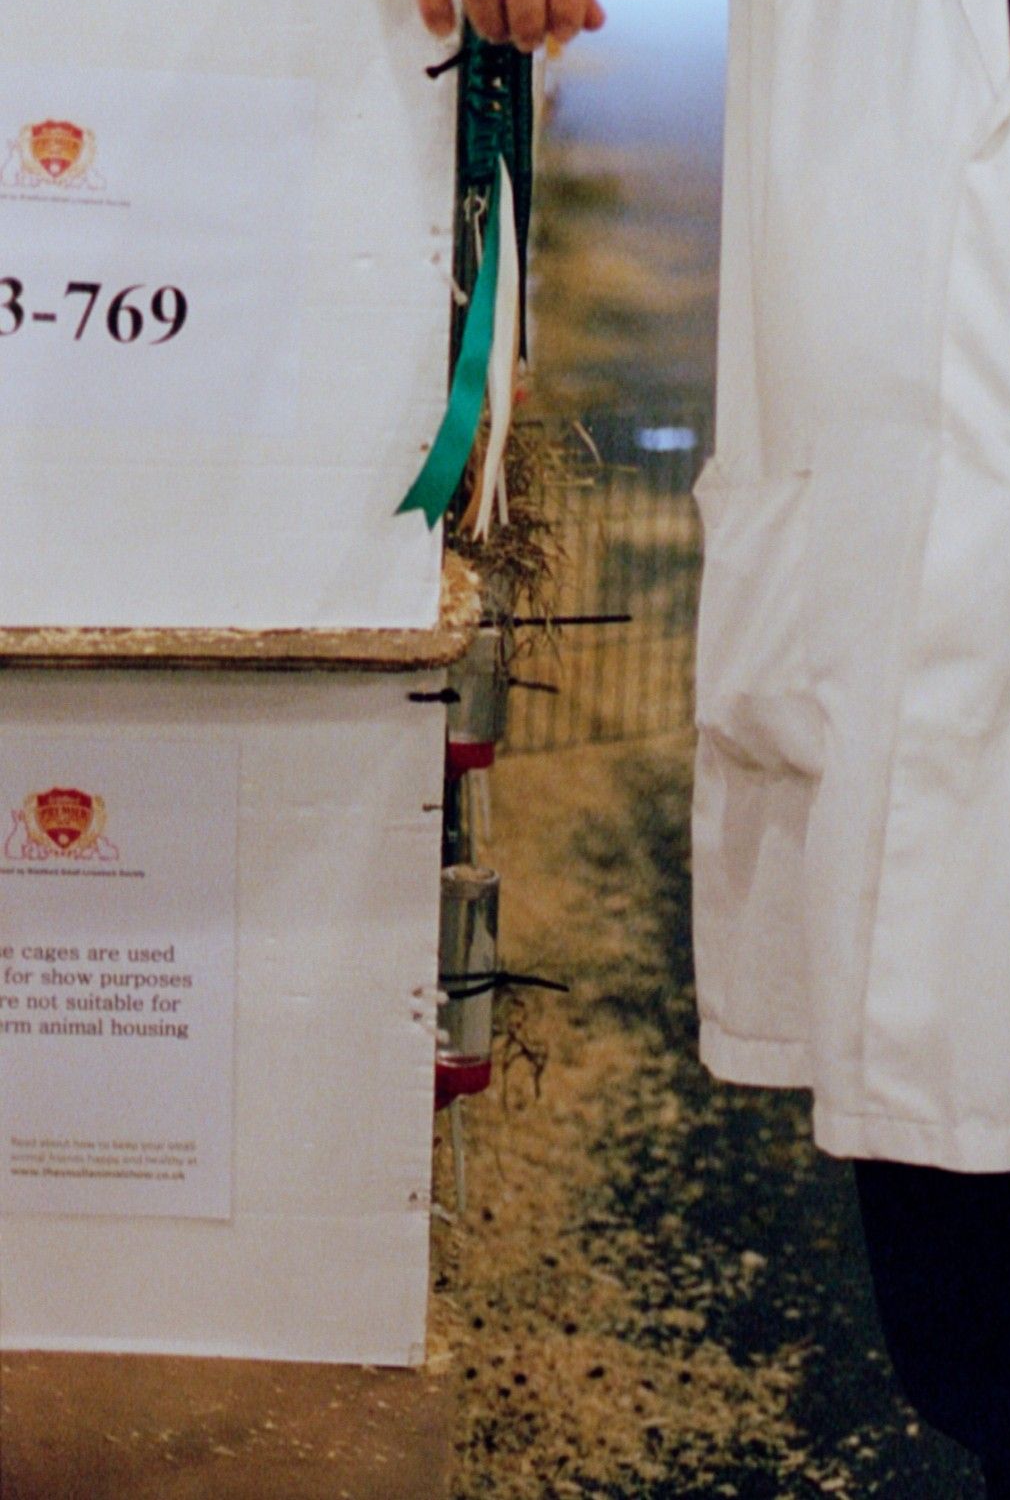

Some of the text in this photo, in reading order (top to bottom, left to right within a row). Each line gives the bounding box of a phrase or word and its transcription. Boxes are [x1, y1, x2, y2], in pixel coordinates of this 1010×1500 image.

[21, 946, 80, 963] cages
[87, 948, 120, 962] are
[127, 945, 176, 963] used
[4, 967, 193, 989] for show purposes
[27, 995, 58, 1010] not
[66, 993, 144, 1012] suitable
[152, 994, 182, 1013] for
[39, 1018, 103, 1036] animal
[111, 1018, 190, 1040] housing
